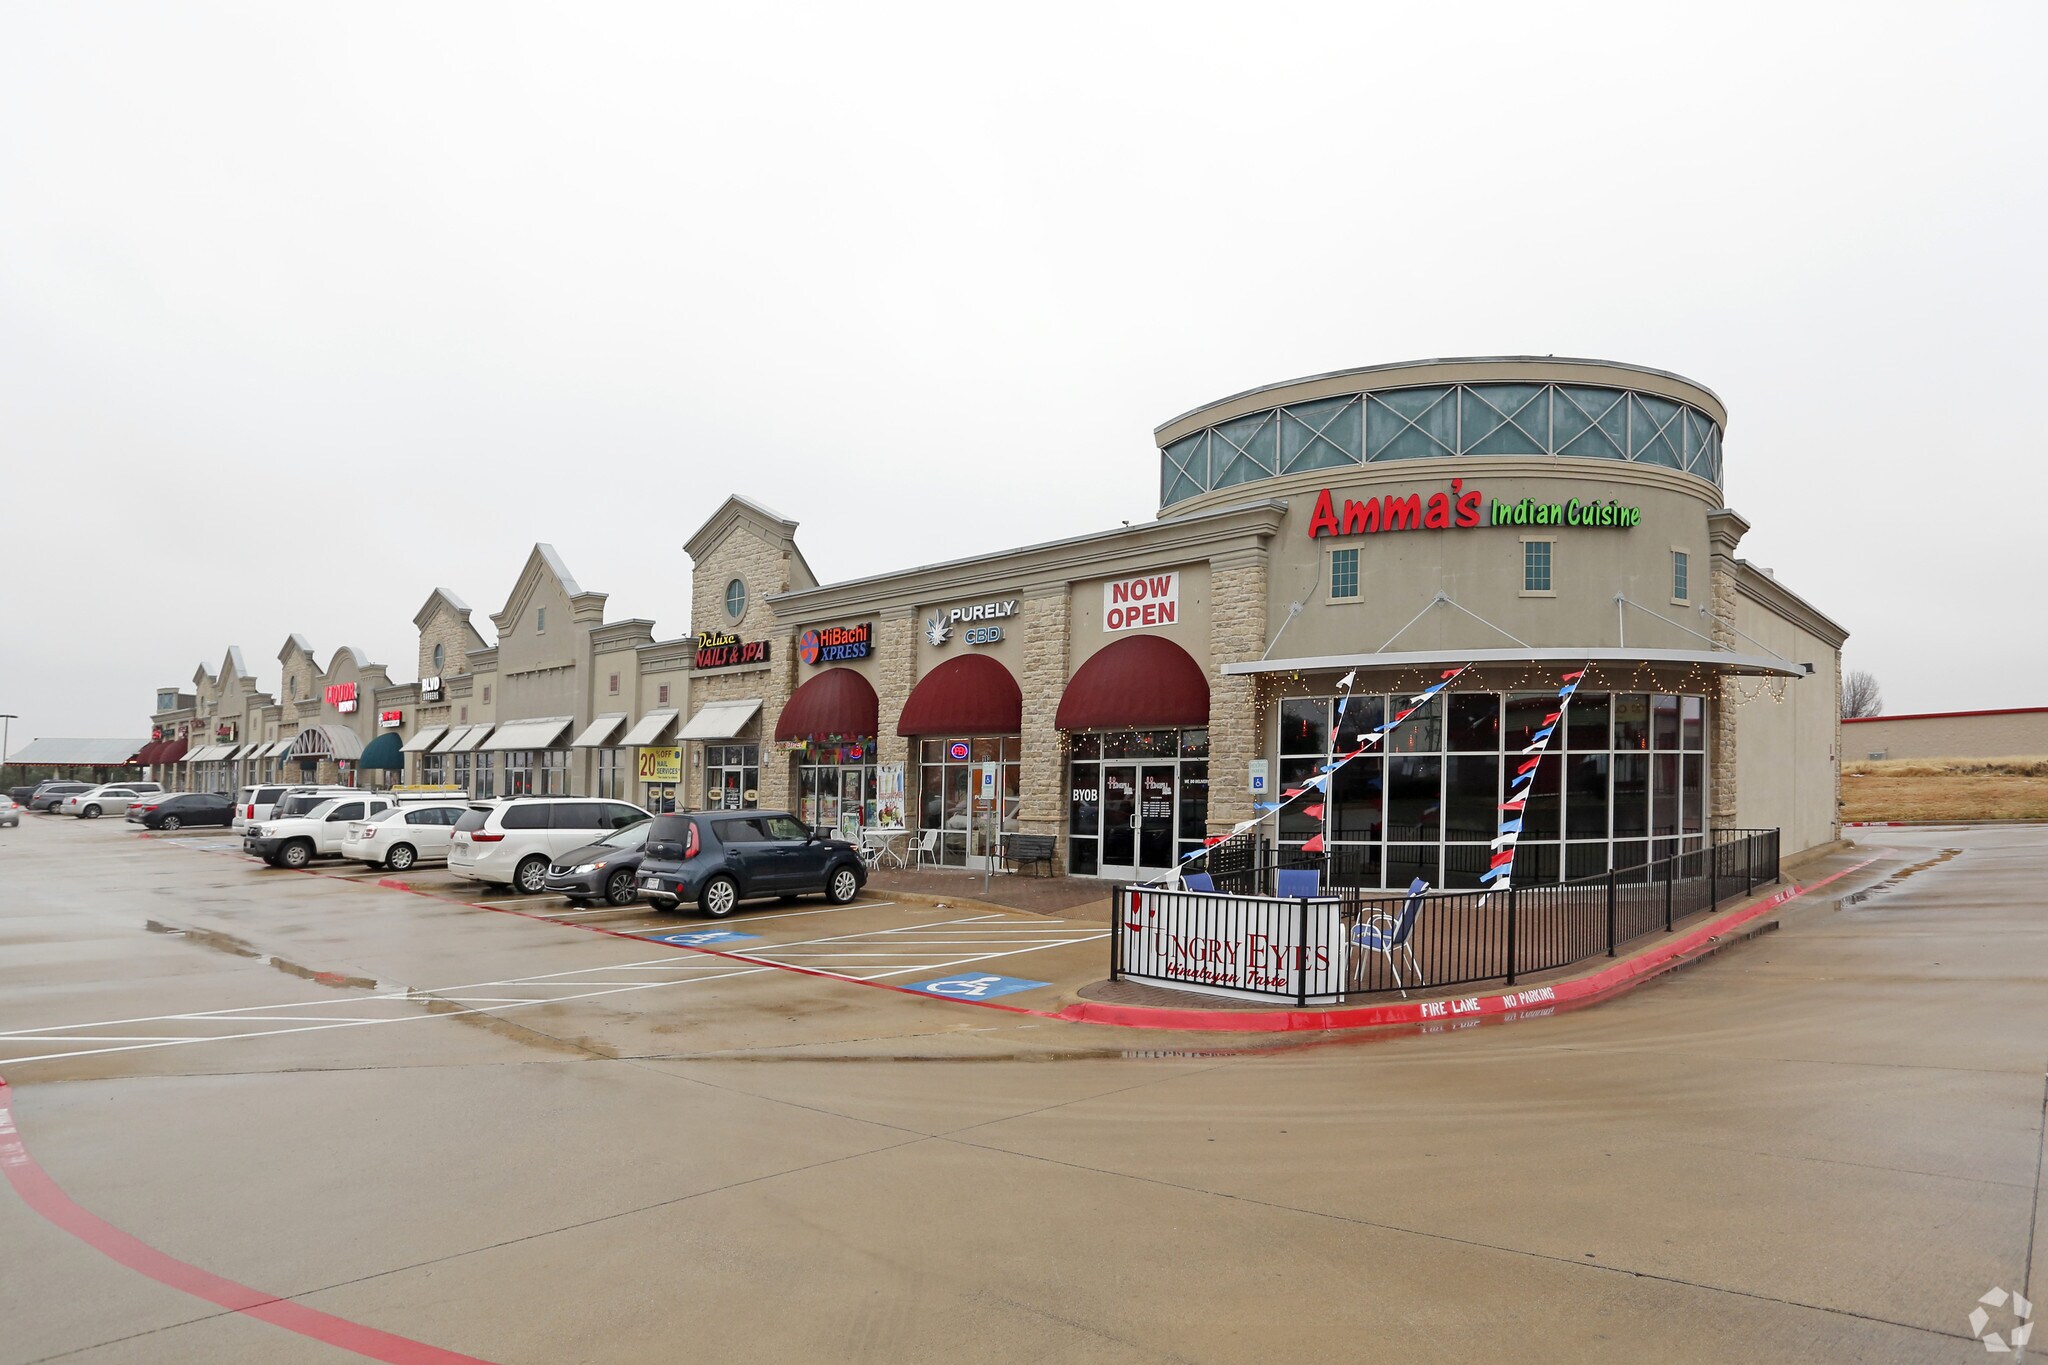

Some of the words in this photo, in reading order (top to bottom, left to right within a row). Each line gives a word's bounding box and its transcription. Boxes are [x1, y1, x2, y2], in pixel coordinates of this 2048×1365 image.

[1308, 478, 1482, 539] Amma's
[1491, 498, 1562, 526] Indian
[1567, 497, 1641, 526] Cuisine
[1113, 575, 1171, 603] NOW
[950, 600, 1015, 623] PURELY
[1107, 601, 1175, 629] OPEN
[698, 632, 736, 648] Deluxe
[820, 624, 867, 646] HiBachi
[964, 626, 1001, 645] CBD
[694, 648, 727, 669] NAILS
[729, 645, 738, 664] &
[741, 641, 764, 662] SPA
[821, 643, 866, 661] XPRESS
[325, 682, 356, 707] LIQUOR
[422, 677, 439, 691] BLVD
[640, 753, 656, 776] 20
[1073, 789, 1098, 802] BYOB
[1248, 933, 1331, 971] EYES
[1167, 962, 1240, 984] Himalayan
[1247, 970, 1288, 988] Taste
[1421, 1001, 1447, 1017] FIRE
[1452, 997, 1480, 1013] LANE
[1503, 995, 1516, 1009] NO
[1518, 987, 1555, 1004] PARKING
